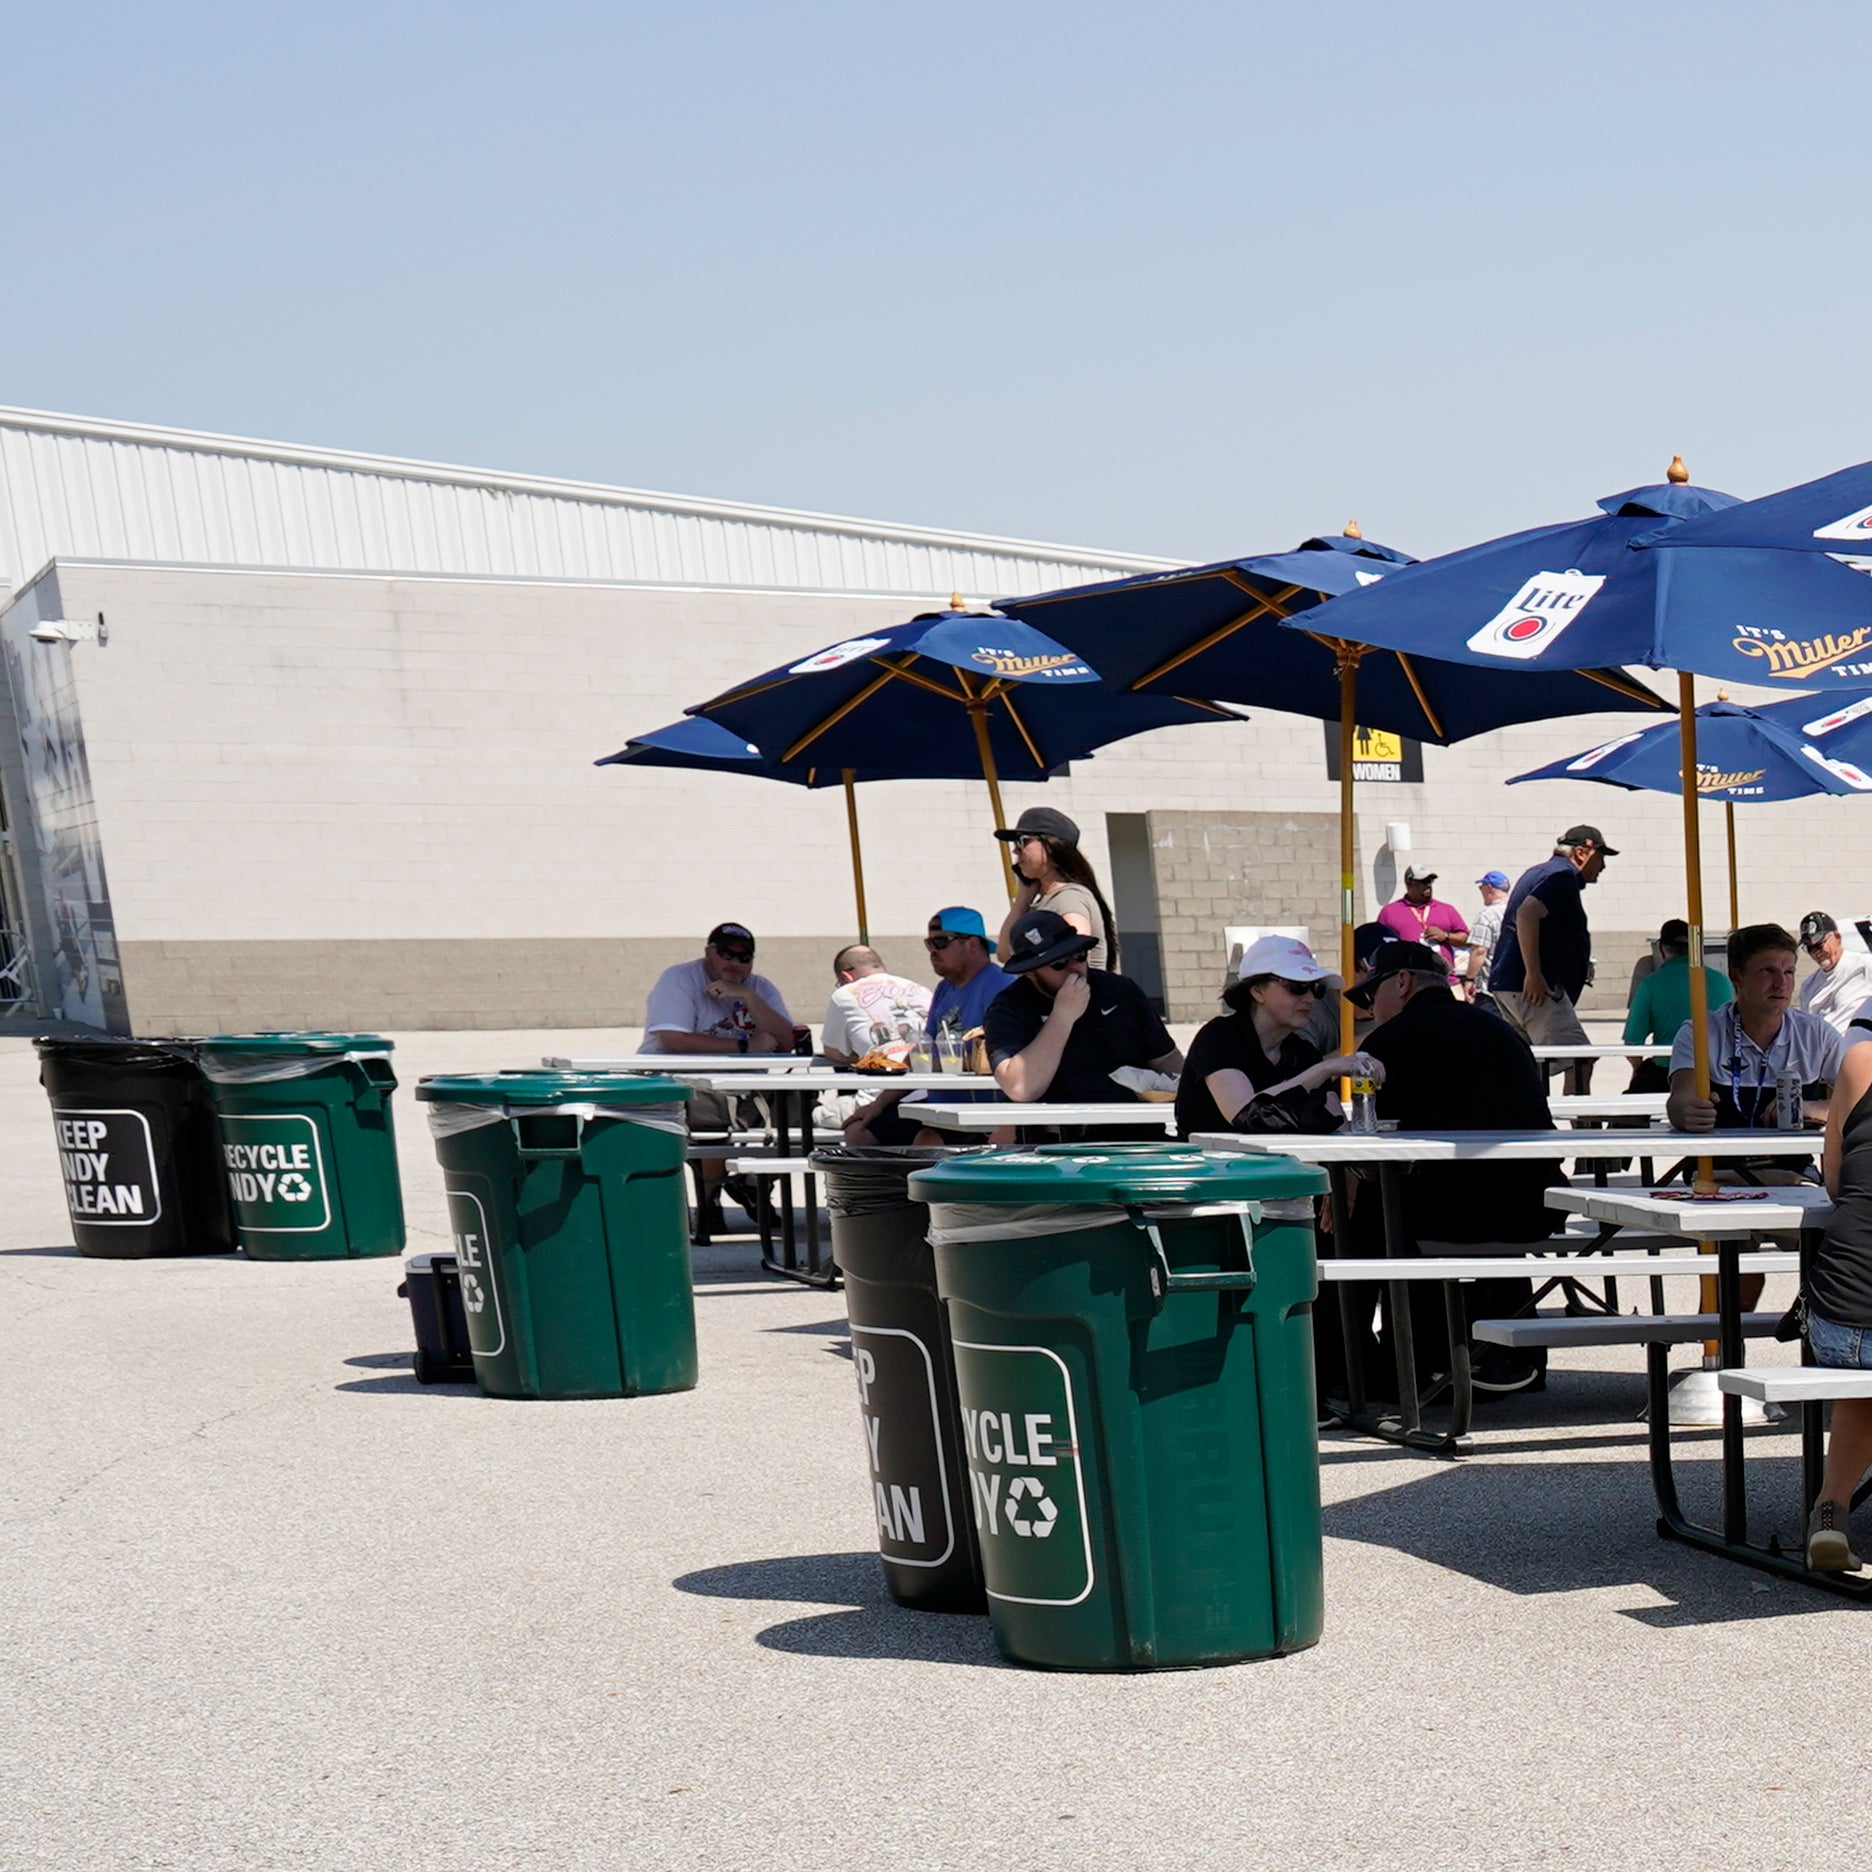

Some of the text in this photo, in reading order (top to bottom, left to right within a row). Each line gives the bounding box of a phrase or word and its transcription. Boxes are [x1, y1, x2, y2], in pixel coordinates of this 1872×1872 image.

[1515, 586, 1587, 613] Lite
[1735, 623, 1787, 641] IT'S
[971, 652, 1078, 677] Miller
[1041, 666, 1090, 679] TIME
[1353, 762, 1401, 782] WOMEN
[1727, 786, 1765, 796] TIME
[63, 1152, 110, 1183] NDY
[230, 1173, 276, 1203] NDY
